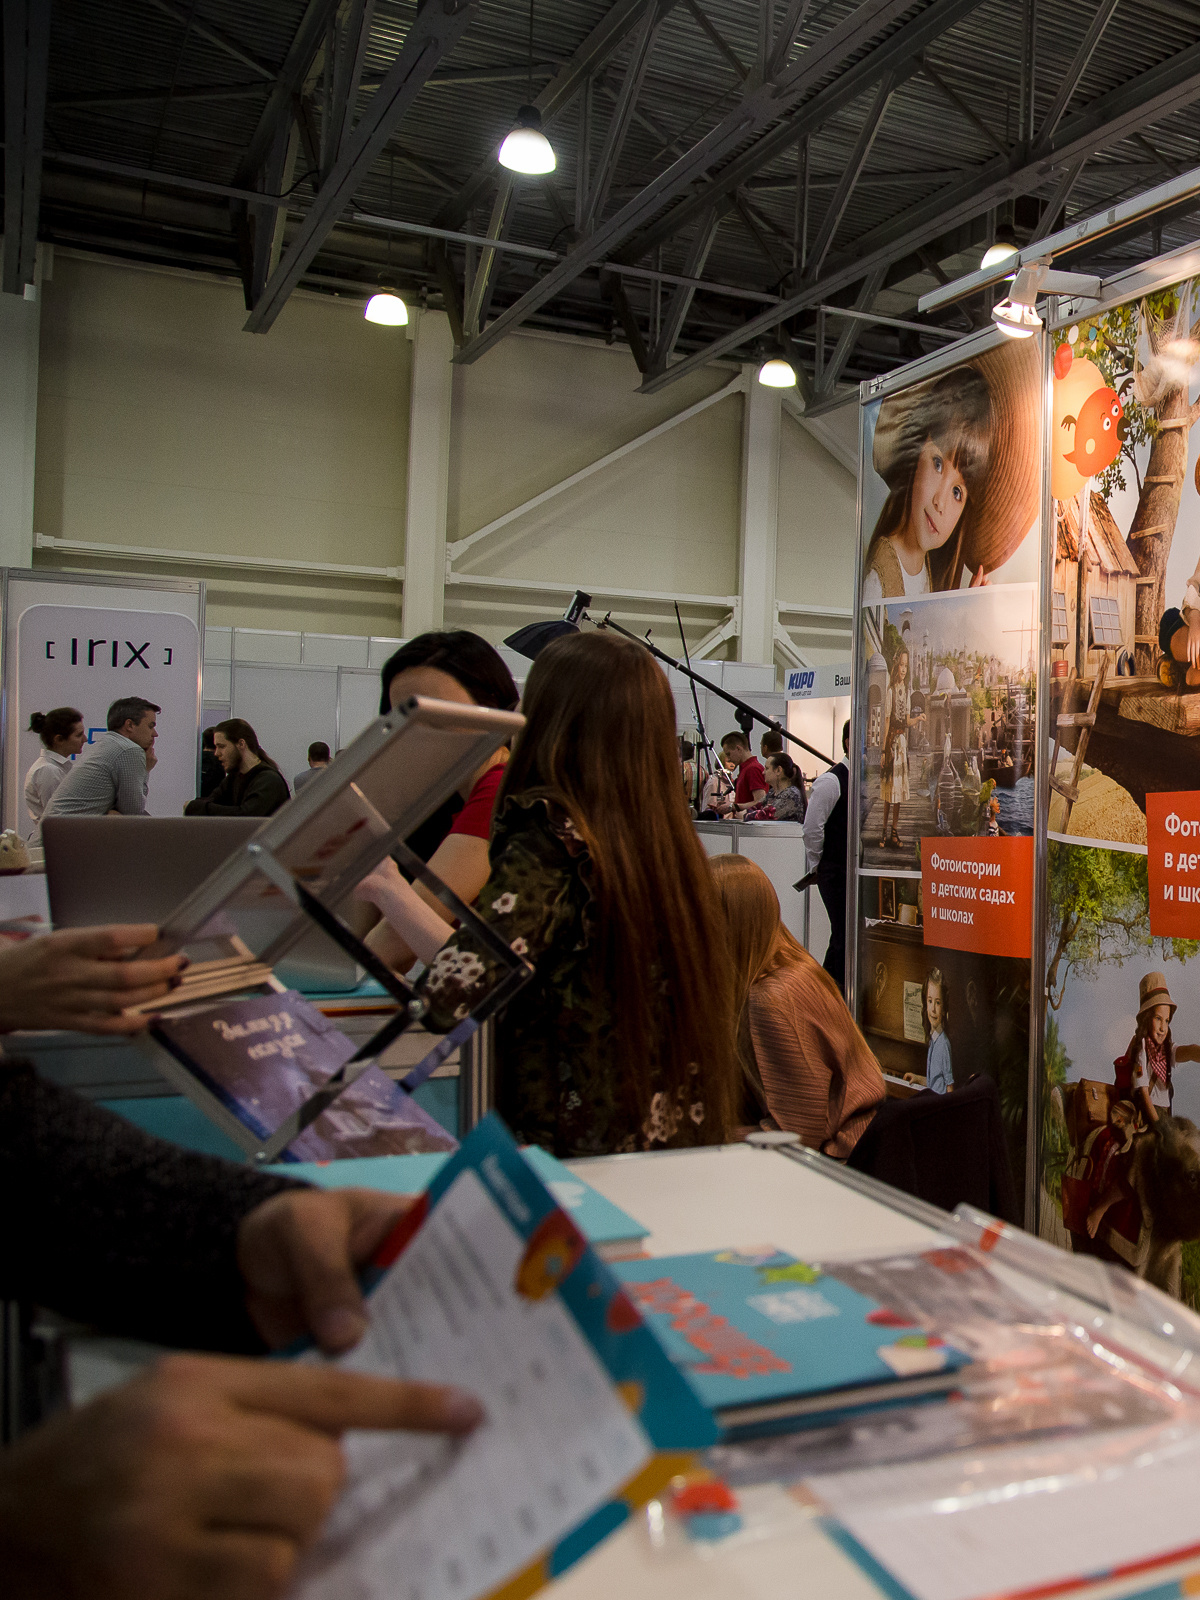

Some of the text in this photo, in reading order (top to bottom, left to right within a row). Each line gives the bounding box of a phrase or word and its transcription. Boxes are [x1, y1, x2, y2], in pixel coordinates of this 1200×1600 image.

[788, 671, 815, 690] KUPO
[931, 852, 1001, 880] Фотоистории
[1164, 852, 1173, 868] в
[931, 882, 1015, 906] в детских садах
[1163, 884, 1174, 901] и
[931, 906, 974, 925] и школах
